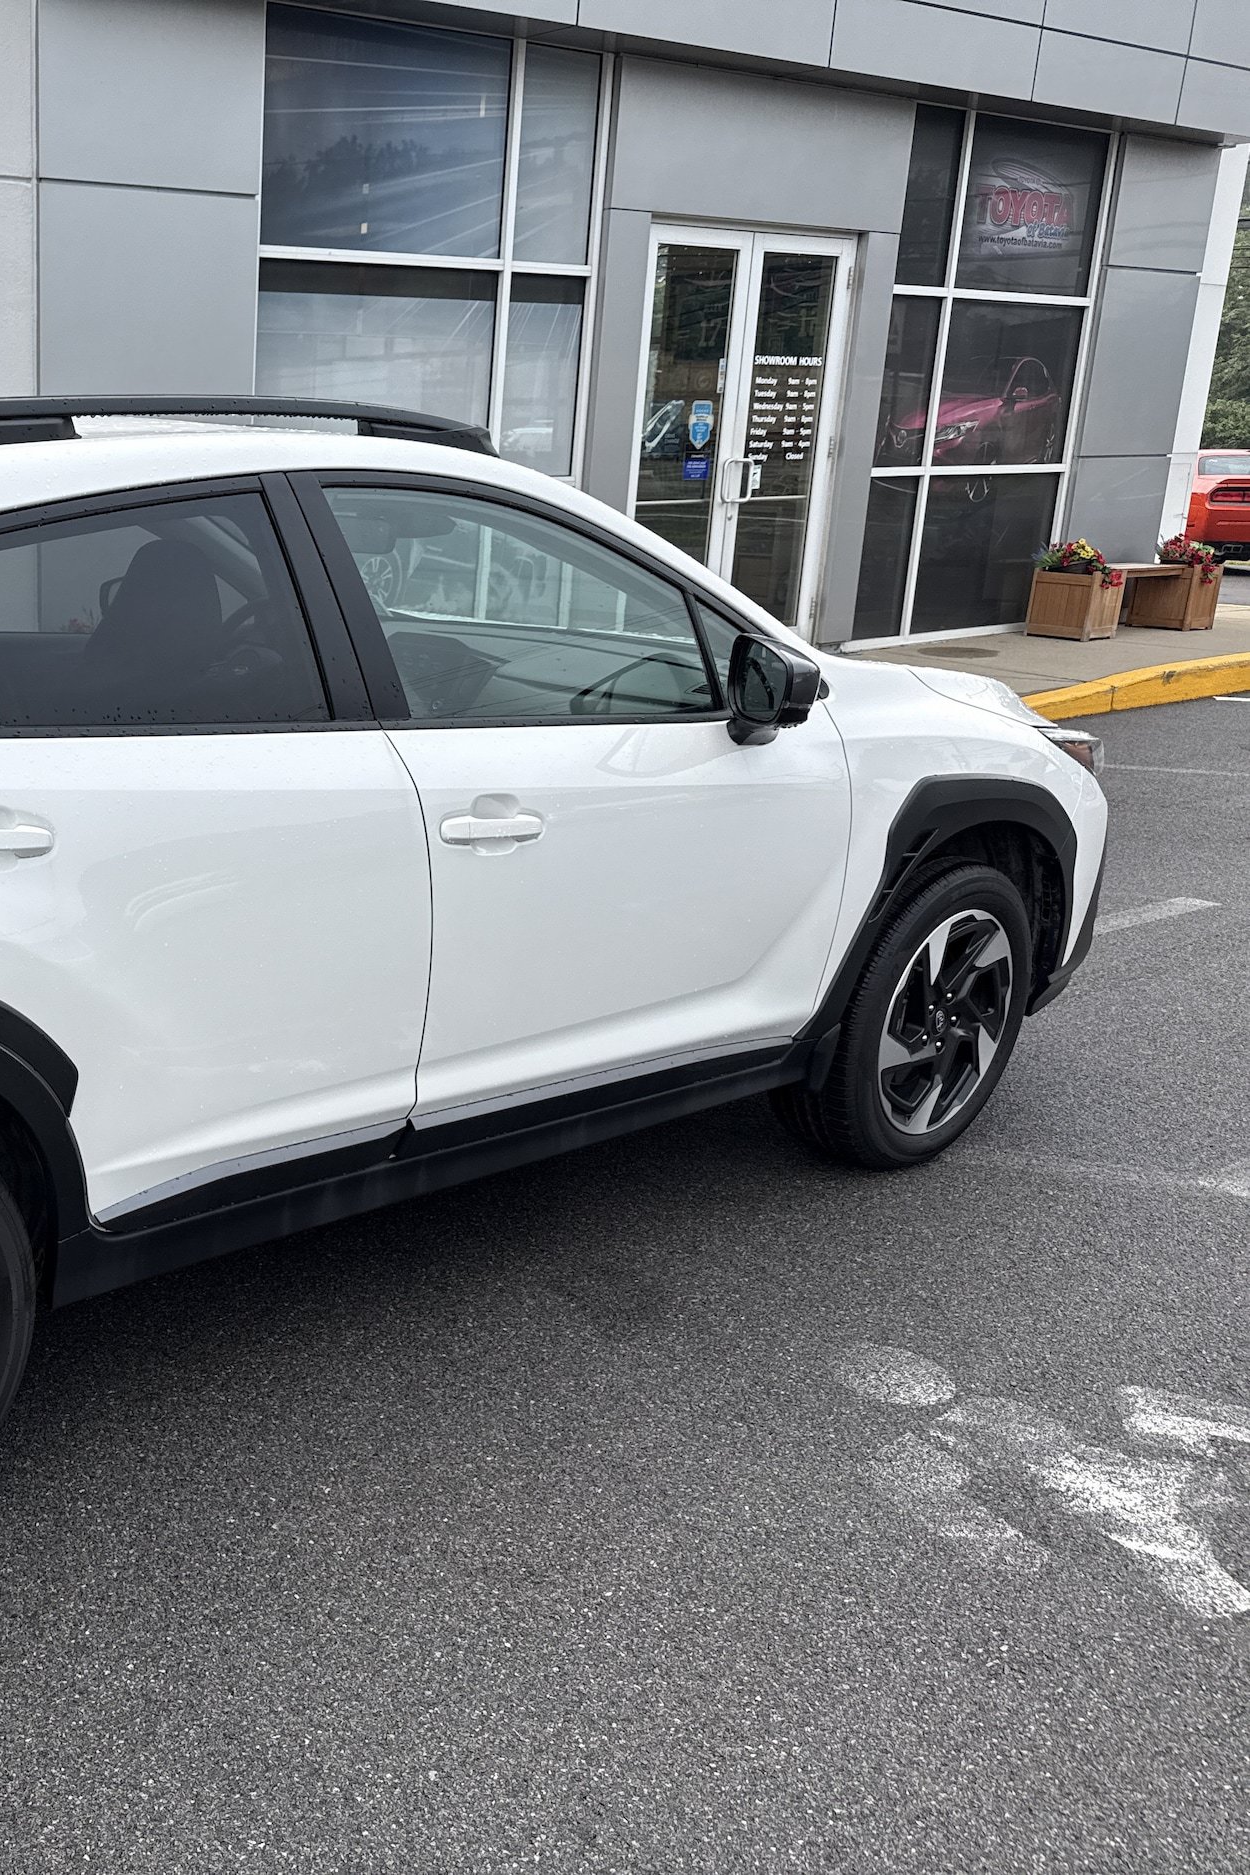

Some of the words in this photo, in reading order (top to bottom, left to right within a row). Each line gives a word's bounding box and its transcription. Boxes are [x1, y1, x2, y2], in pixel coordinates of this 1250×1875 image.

[976, 184, 1072, 227] TOYOTA
[754, 355, 798, 365] SHOWROOM
[799, 356, 823, 366] HOURS
[755, 377, 778, 386] Monday
[755, 389, 777, 399] Tuesday
[753, 403, 784, 412] Wednesday
[752, 415, 777, 424] Thursday
[750, 428, 767, 437] Friday
[749, 440, 774, 449] Saturday
[748, 453, 768, 462] Sunday
[786, 452, 804, 460] Closed
